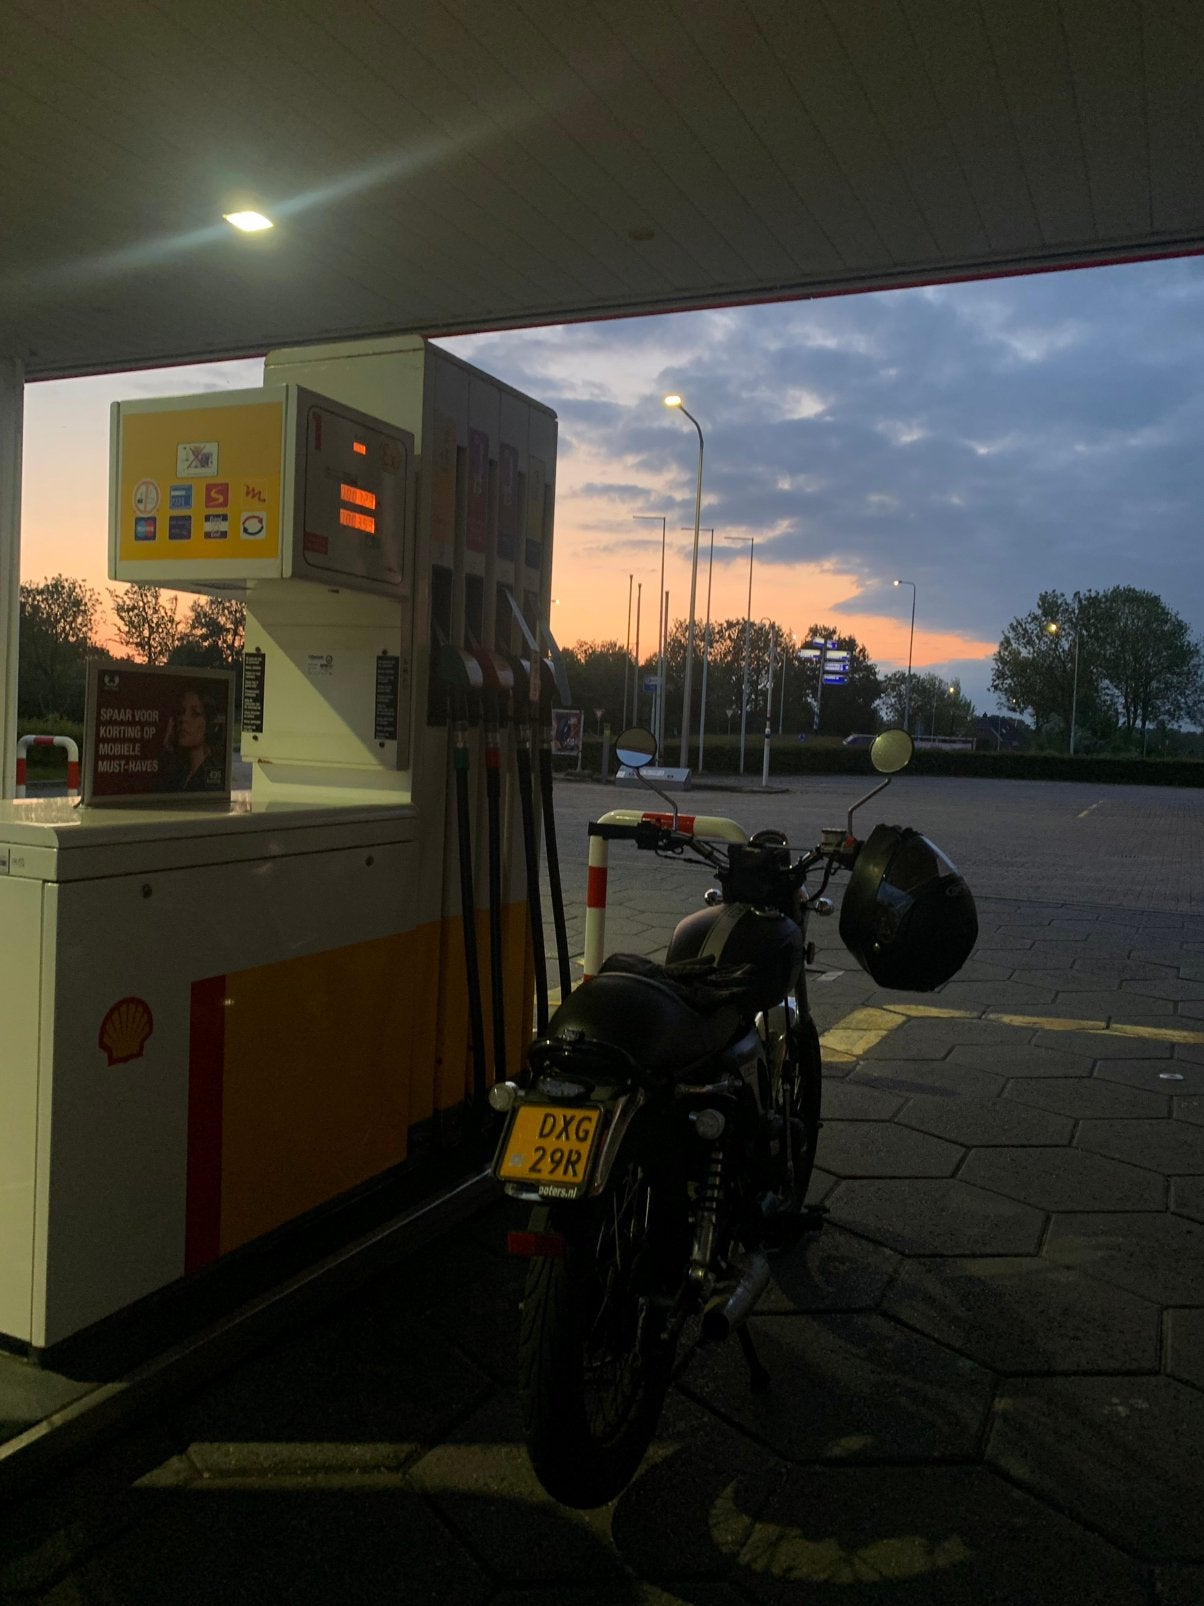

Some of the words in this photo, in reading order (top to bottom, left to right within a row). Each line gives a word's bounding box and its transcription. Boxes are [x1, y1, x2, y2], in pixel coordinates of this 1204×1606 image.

[100, 708, 132, 721] SPAAR
[134, 709, 159, 722] VOOR
[99, 725, 141, 739] KORTING
[143, 726, 157, 739] OP
[98, 743, 141, 756] MOBIELE
[97, 760, 159, 773] MUST-HAVES
[539, 1113, 592, 1142] DXG
[528, 1146, 582, 1177] 29R
